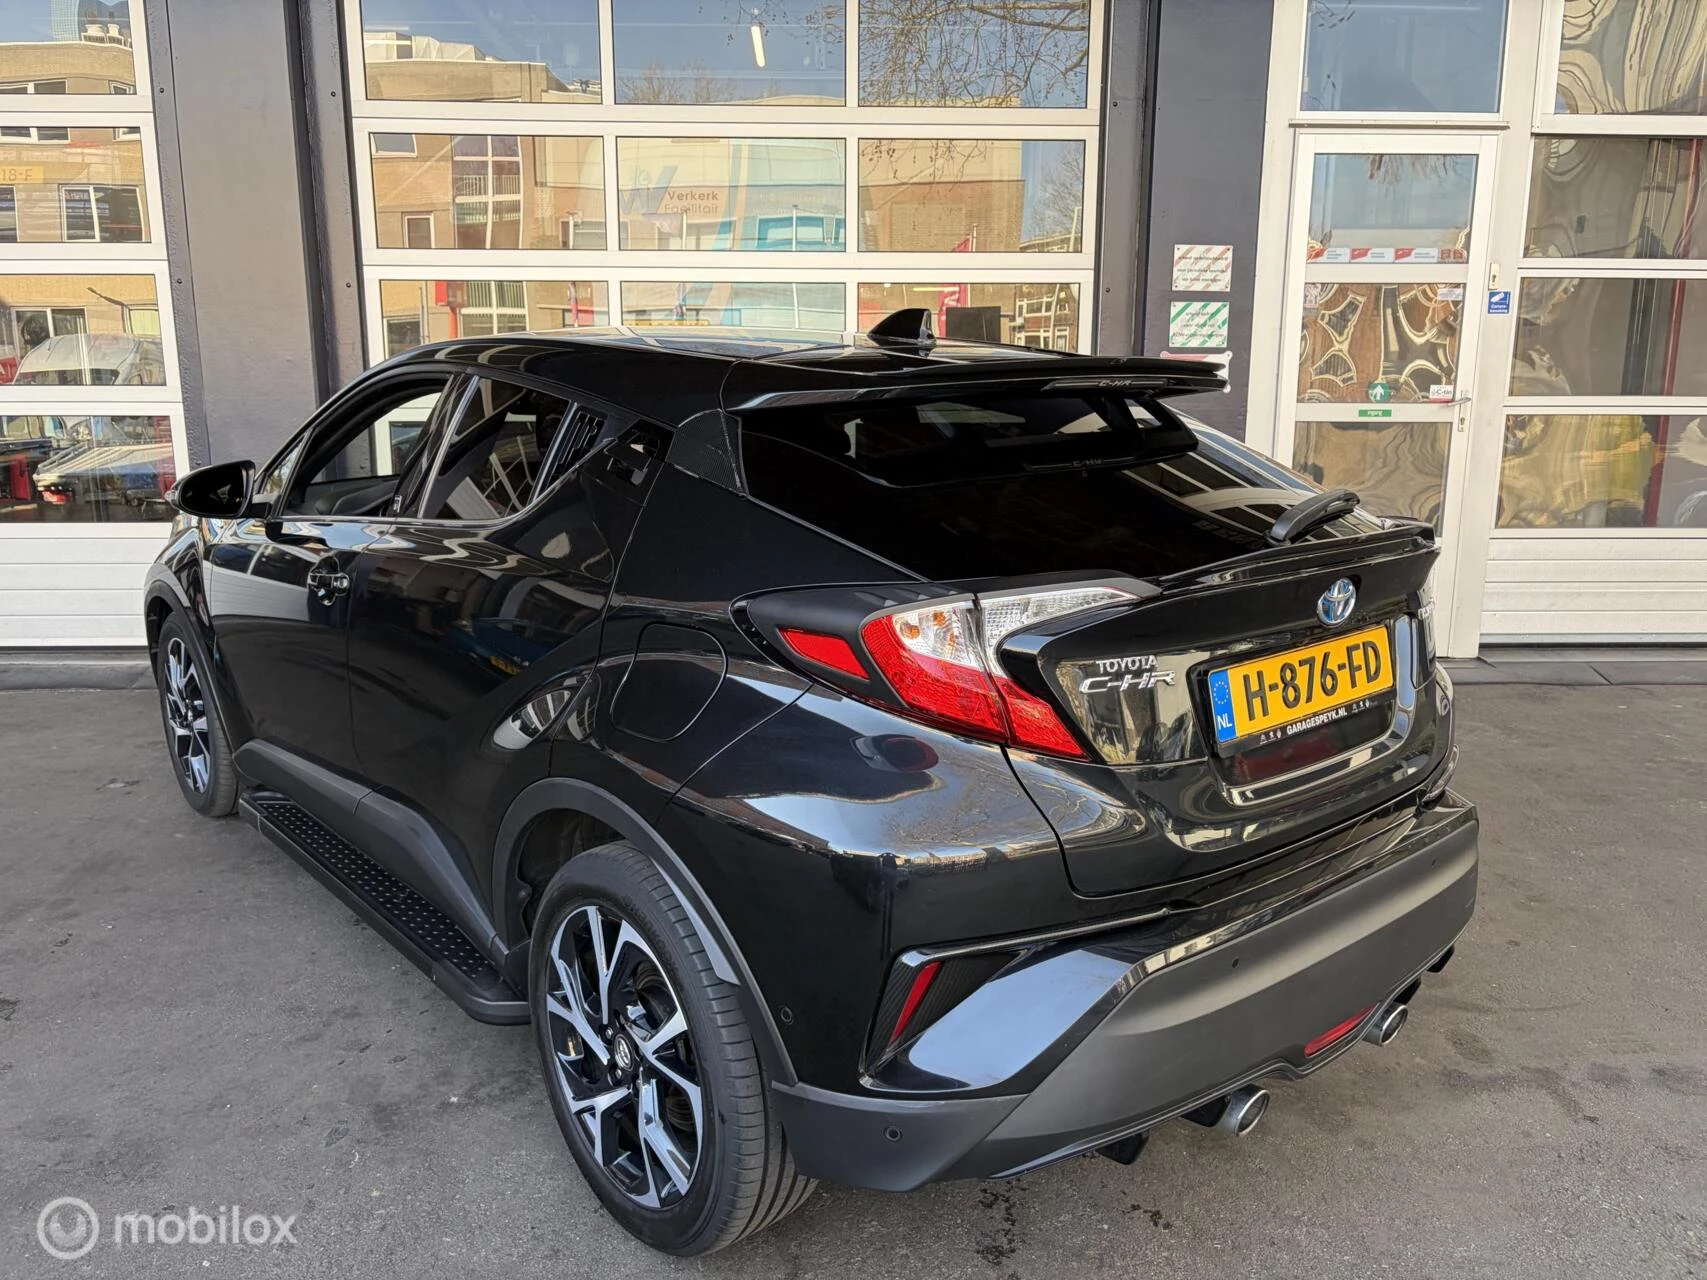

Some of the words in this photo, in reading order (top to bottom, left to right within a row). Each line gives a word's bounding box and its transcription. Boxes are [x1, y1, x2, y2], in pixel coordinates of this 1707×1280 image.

[667, 191, 719, 201] Verkerk
[1099, 379, 1132, 387] C-HR
[1096, 655, 1158, 674] TOYOTA
[1078, 671, 1176, 694] C-HR
[1243, 640, 1382, 720] H-876-FD
[1217, 713, 1233, 729] NL
[1286, 707, 1347, 735] GARAGESPEYK.NL
